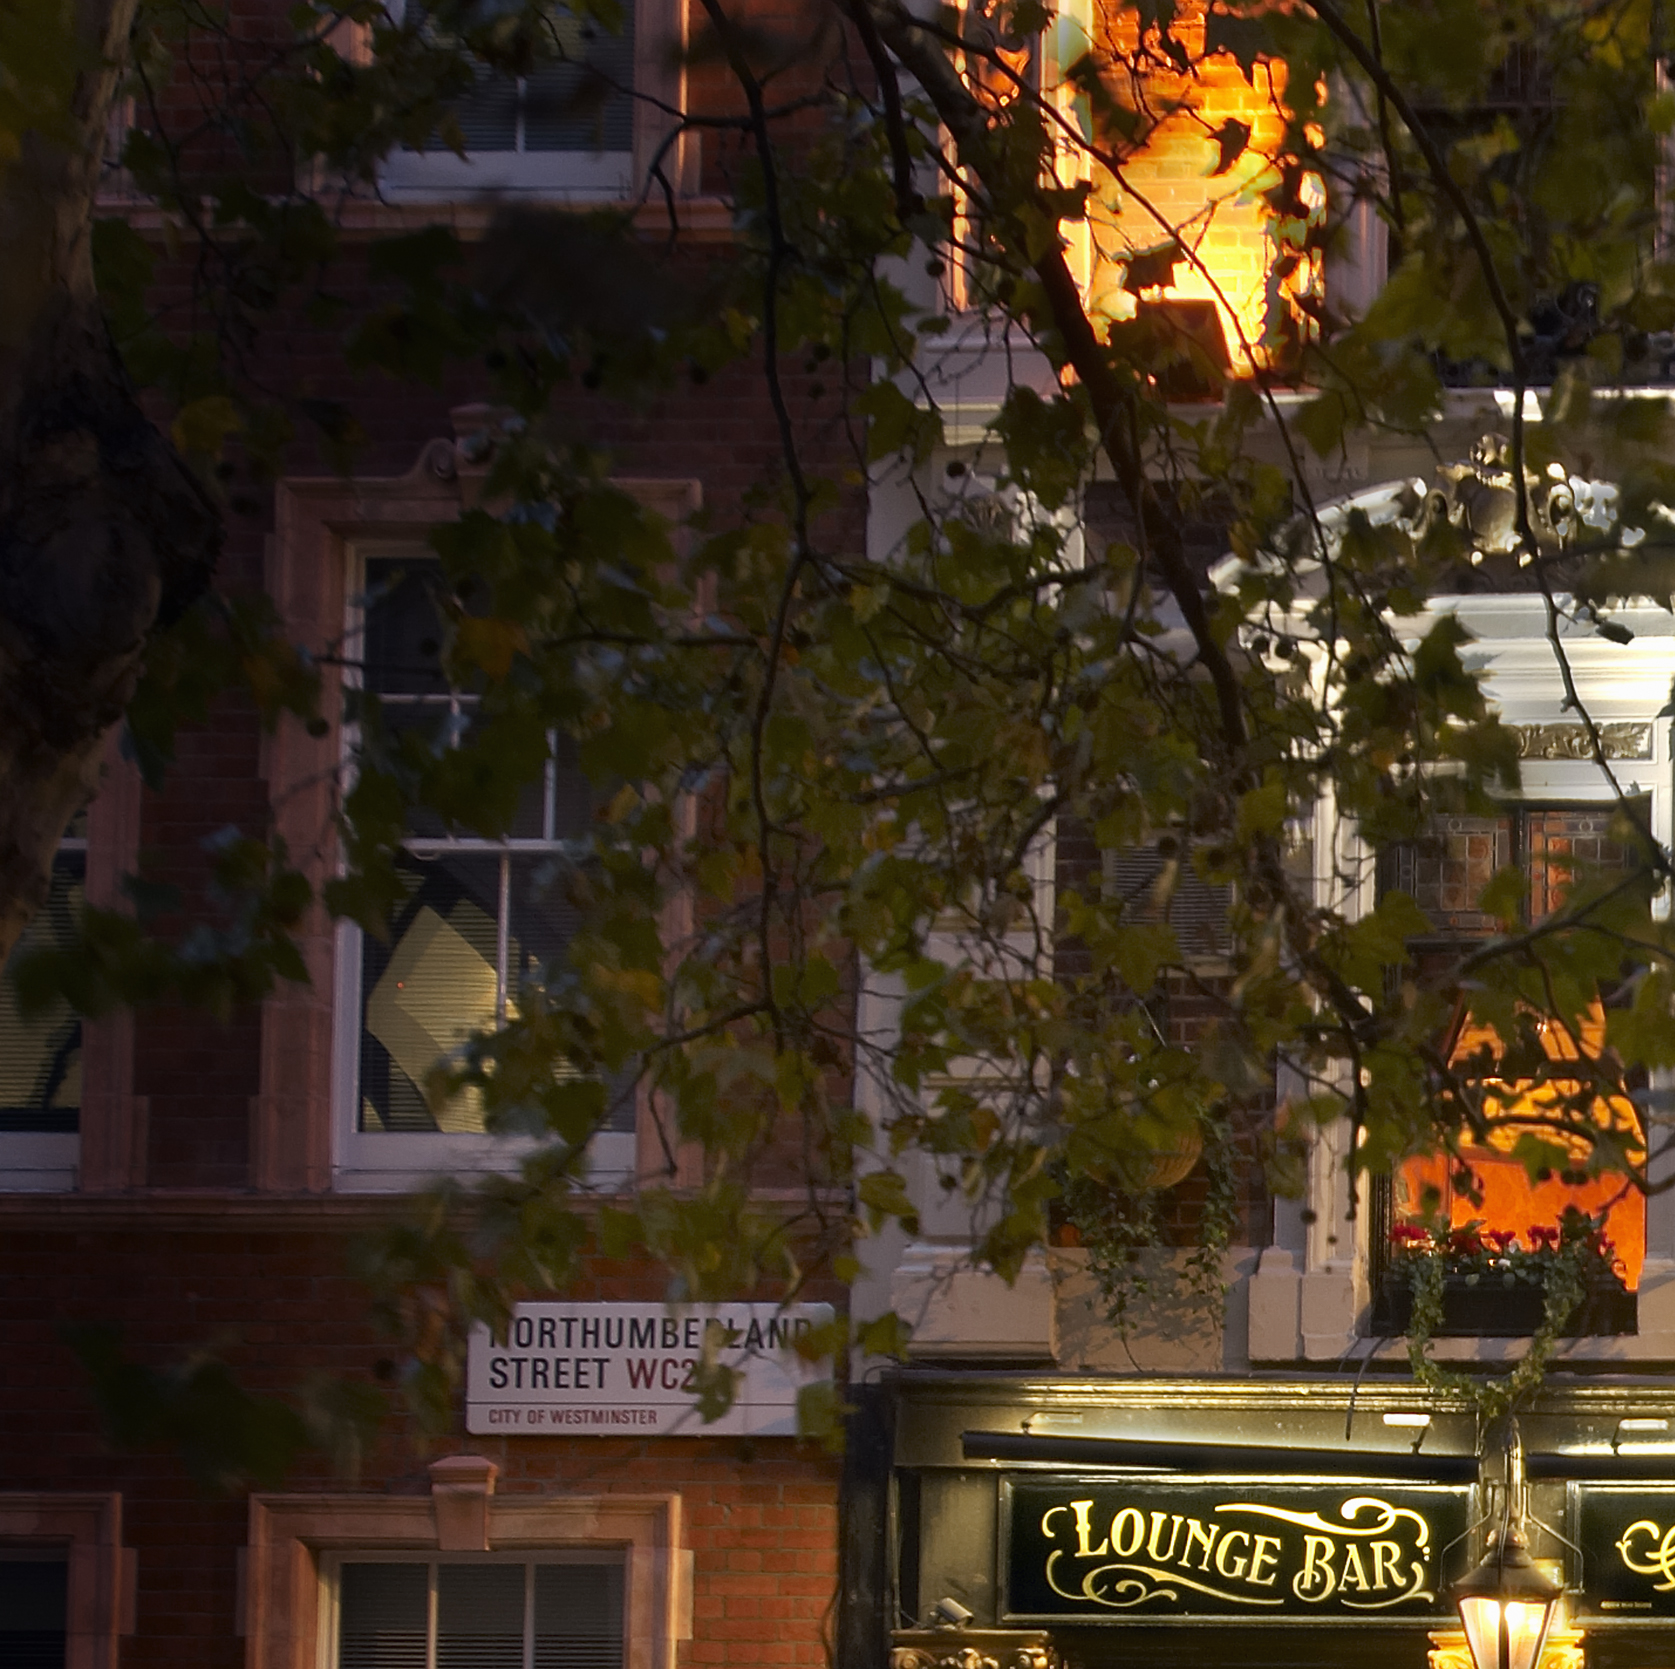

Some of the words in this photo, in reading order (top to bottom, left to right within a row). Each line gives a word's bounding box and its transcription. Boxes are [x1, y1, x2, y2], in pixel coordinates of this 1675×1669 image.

[489, 1356, 610, 1390] STREET
[488, 1409, 520, 1425] CITY
[527, 1409, 546, 1425] OF
[550, 1409, 658, 1426] WESTMINSTER
[1070, 1499, 1282, 1586] LOUNGE
[1293, 1534, 1408, 1603] BAR
